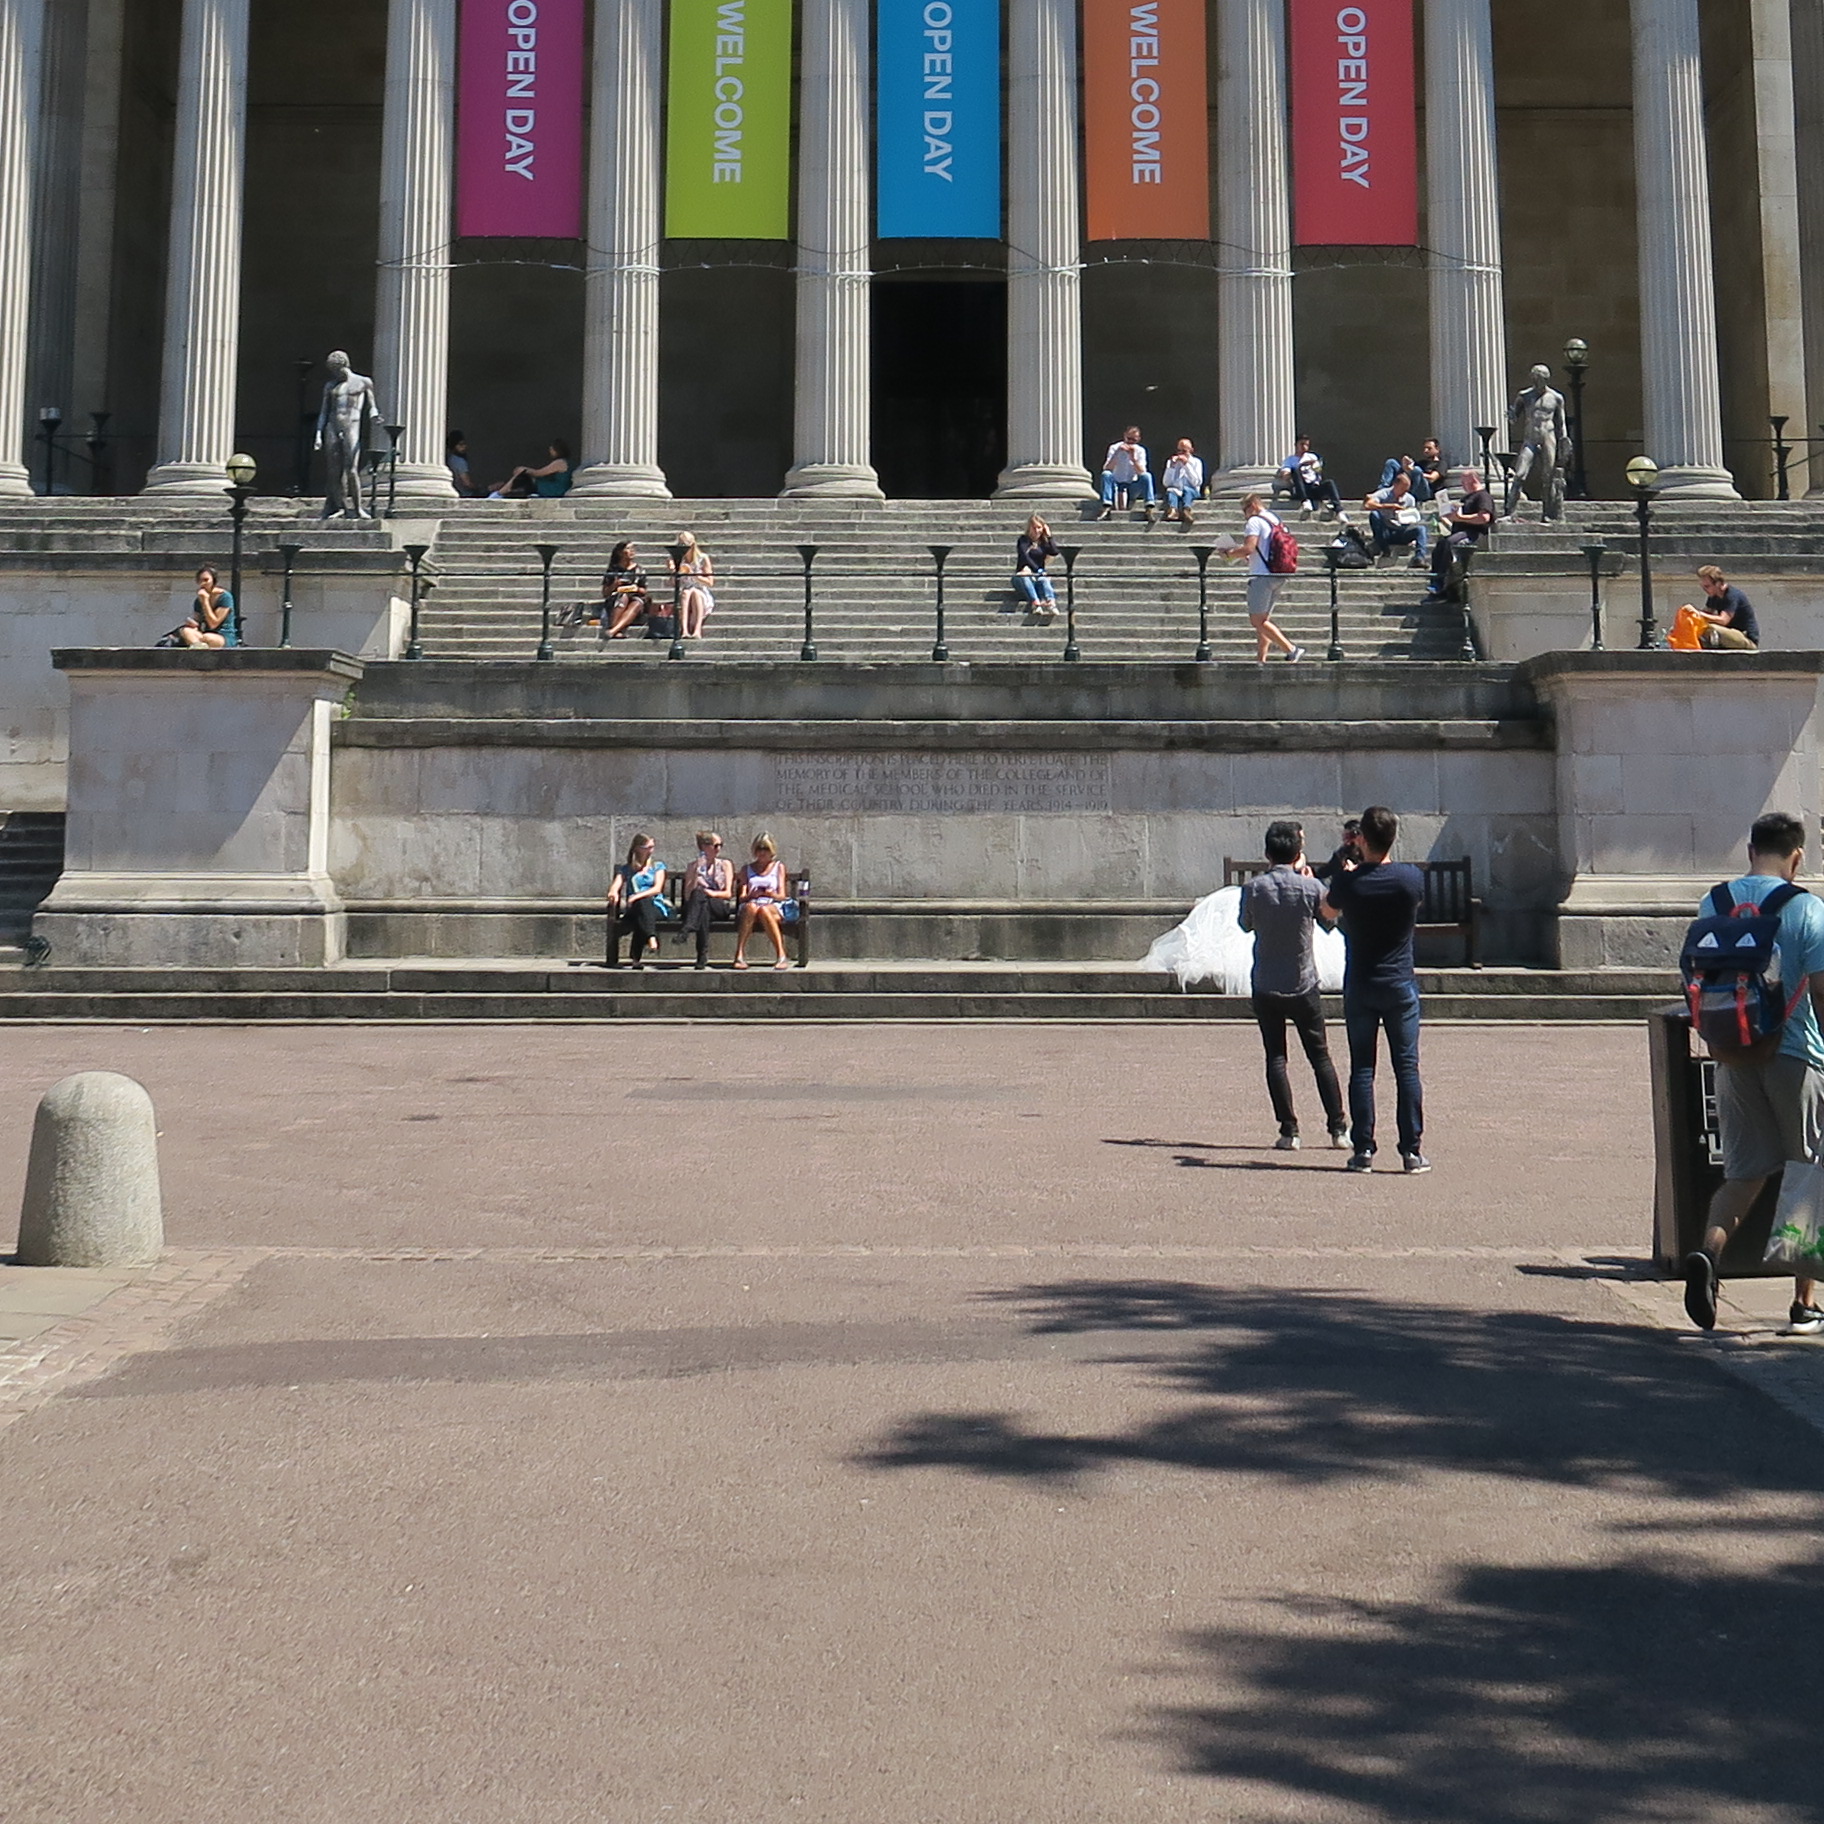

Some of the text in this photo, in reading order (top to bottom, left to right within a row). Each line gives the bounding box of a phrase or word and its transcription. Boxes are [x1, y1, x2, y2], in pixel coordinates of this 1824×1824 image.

[712, 0, 746, 184] WELCOME
[922, 0, 953, 183] OPEN DAY
[1130, 1, 1162, 184] WELCOME
[1336, 6, 1370, 189] OPEN DAY
[504, 108, 535, 181] DAY
[777, 768, 1107, 780] MEMORY OF THE MEMBERS OF THE COLLEGE AND OF
[777, 783, 1107, 795] THE MEDICAL SCHOOL WHO DIED IN THE SERVICE
[806, 753, 885, 765] INSCRIPTION
[776, 799, 793, 811] OF
[796, 799, 835, 811] THEIR
[839, 799, 903, 811] COUNTRY
[909, 799, 965, 811] DURING
